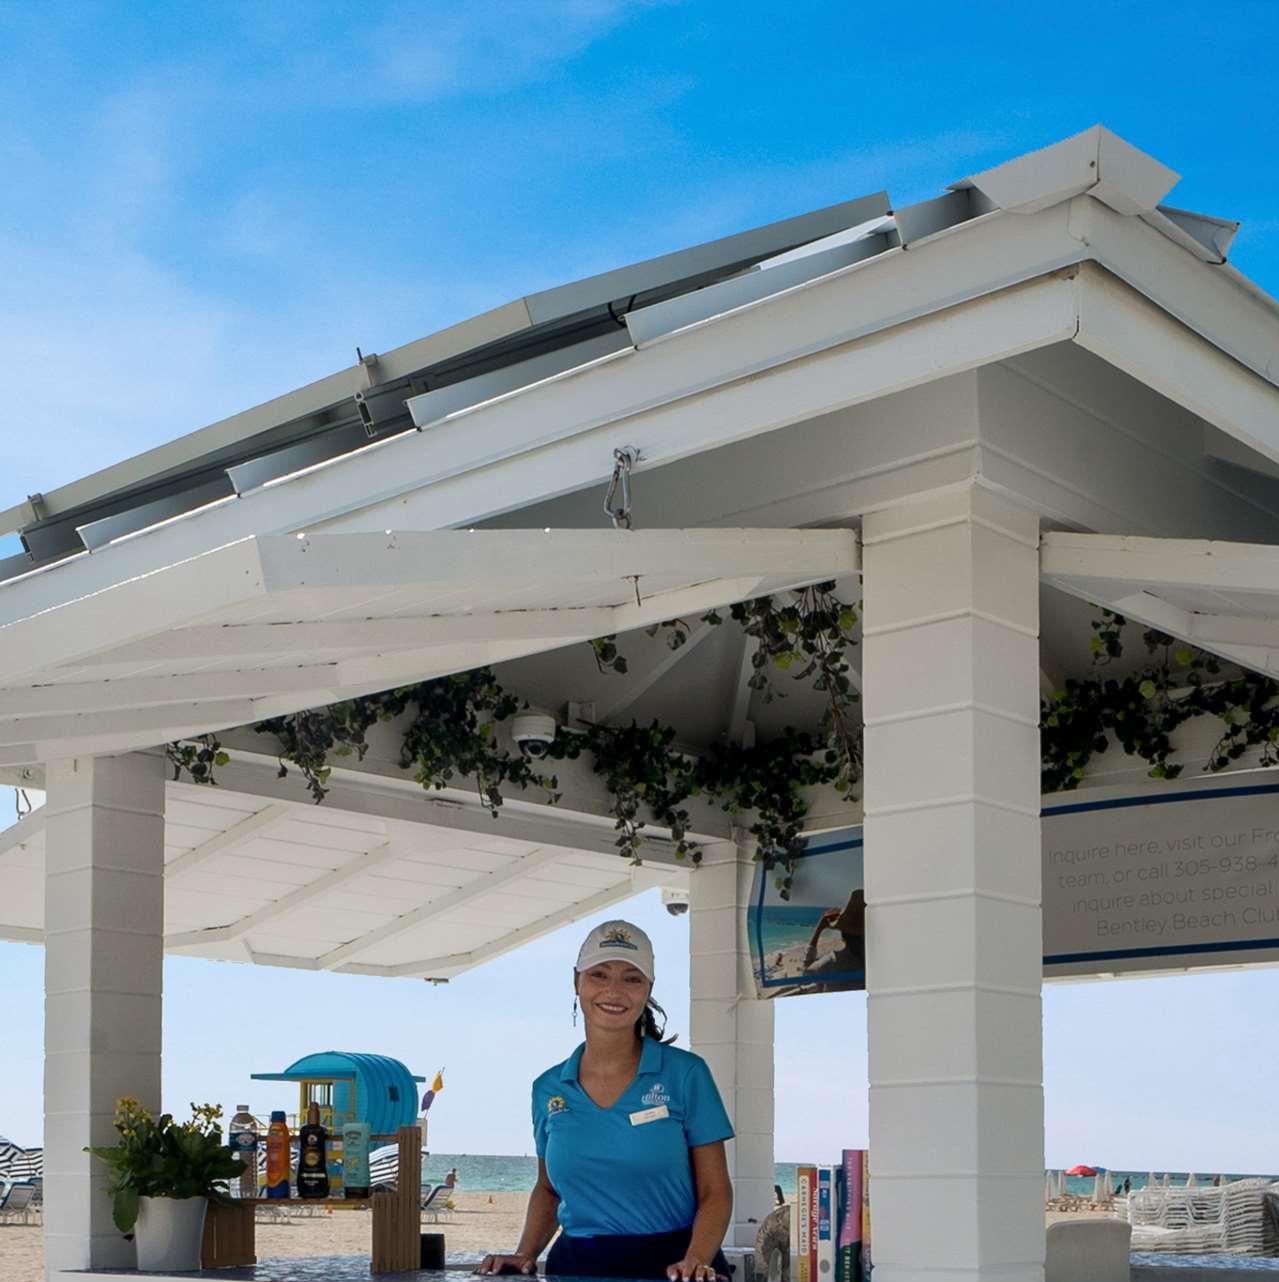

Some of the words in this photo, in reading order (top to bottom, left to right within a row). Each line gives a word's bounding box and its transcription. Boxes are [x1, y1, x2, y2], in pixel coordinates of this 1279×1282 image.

[1048, 845, 1110, 865] Inquire
[1166, 835, 1203, 852] visit
[1211, 833, 1246, 849] our
[1113, 869, 1133, 884] or
[1136, 864, 1169, 881] call
[1073, 894, 1134, 913] inquire
[1138, 888, 1195, 906] about
[1201, 880, 1273, 902] special
[1096, 917, 1168, 937] Bentley
[1173, 911, 1236, 931] Beach
